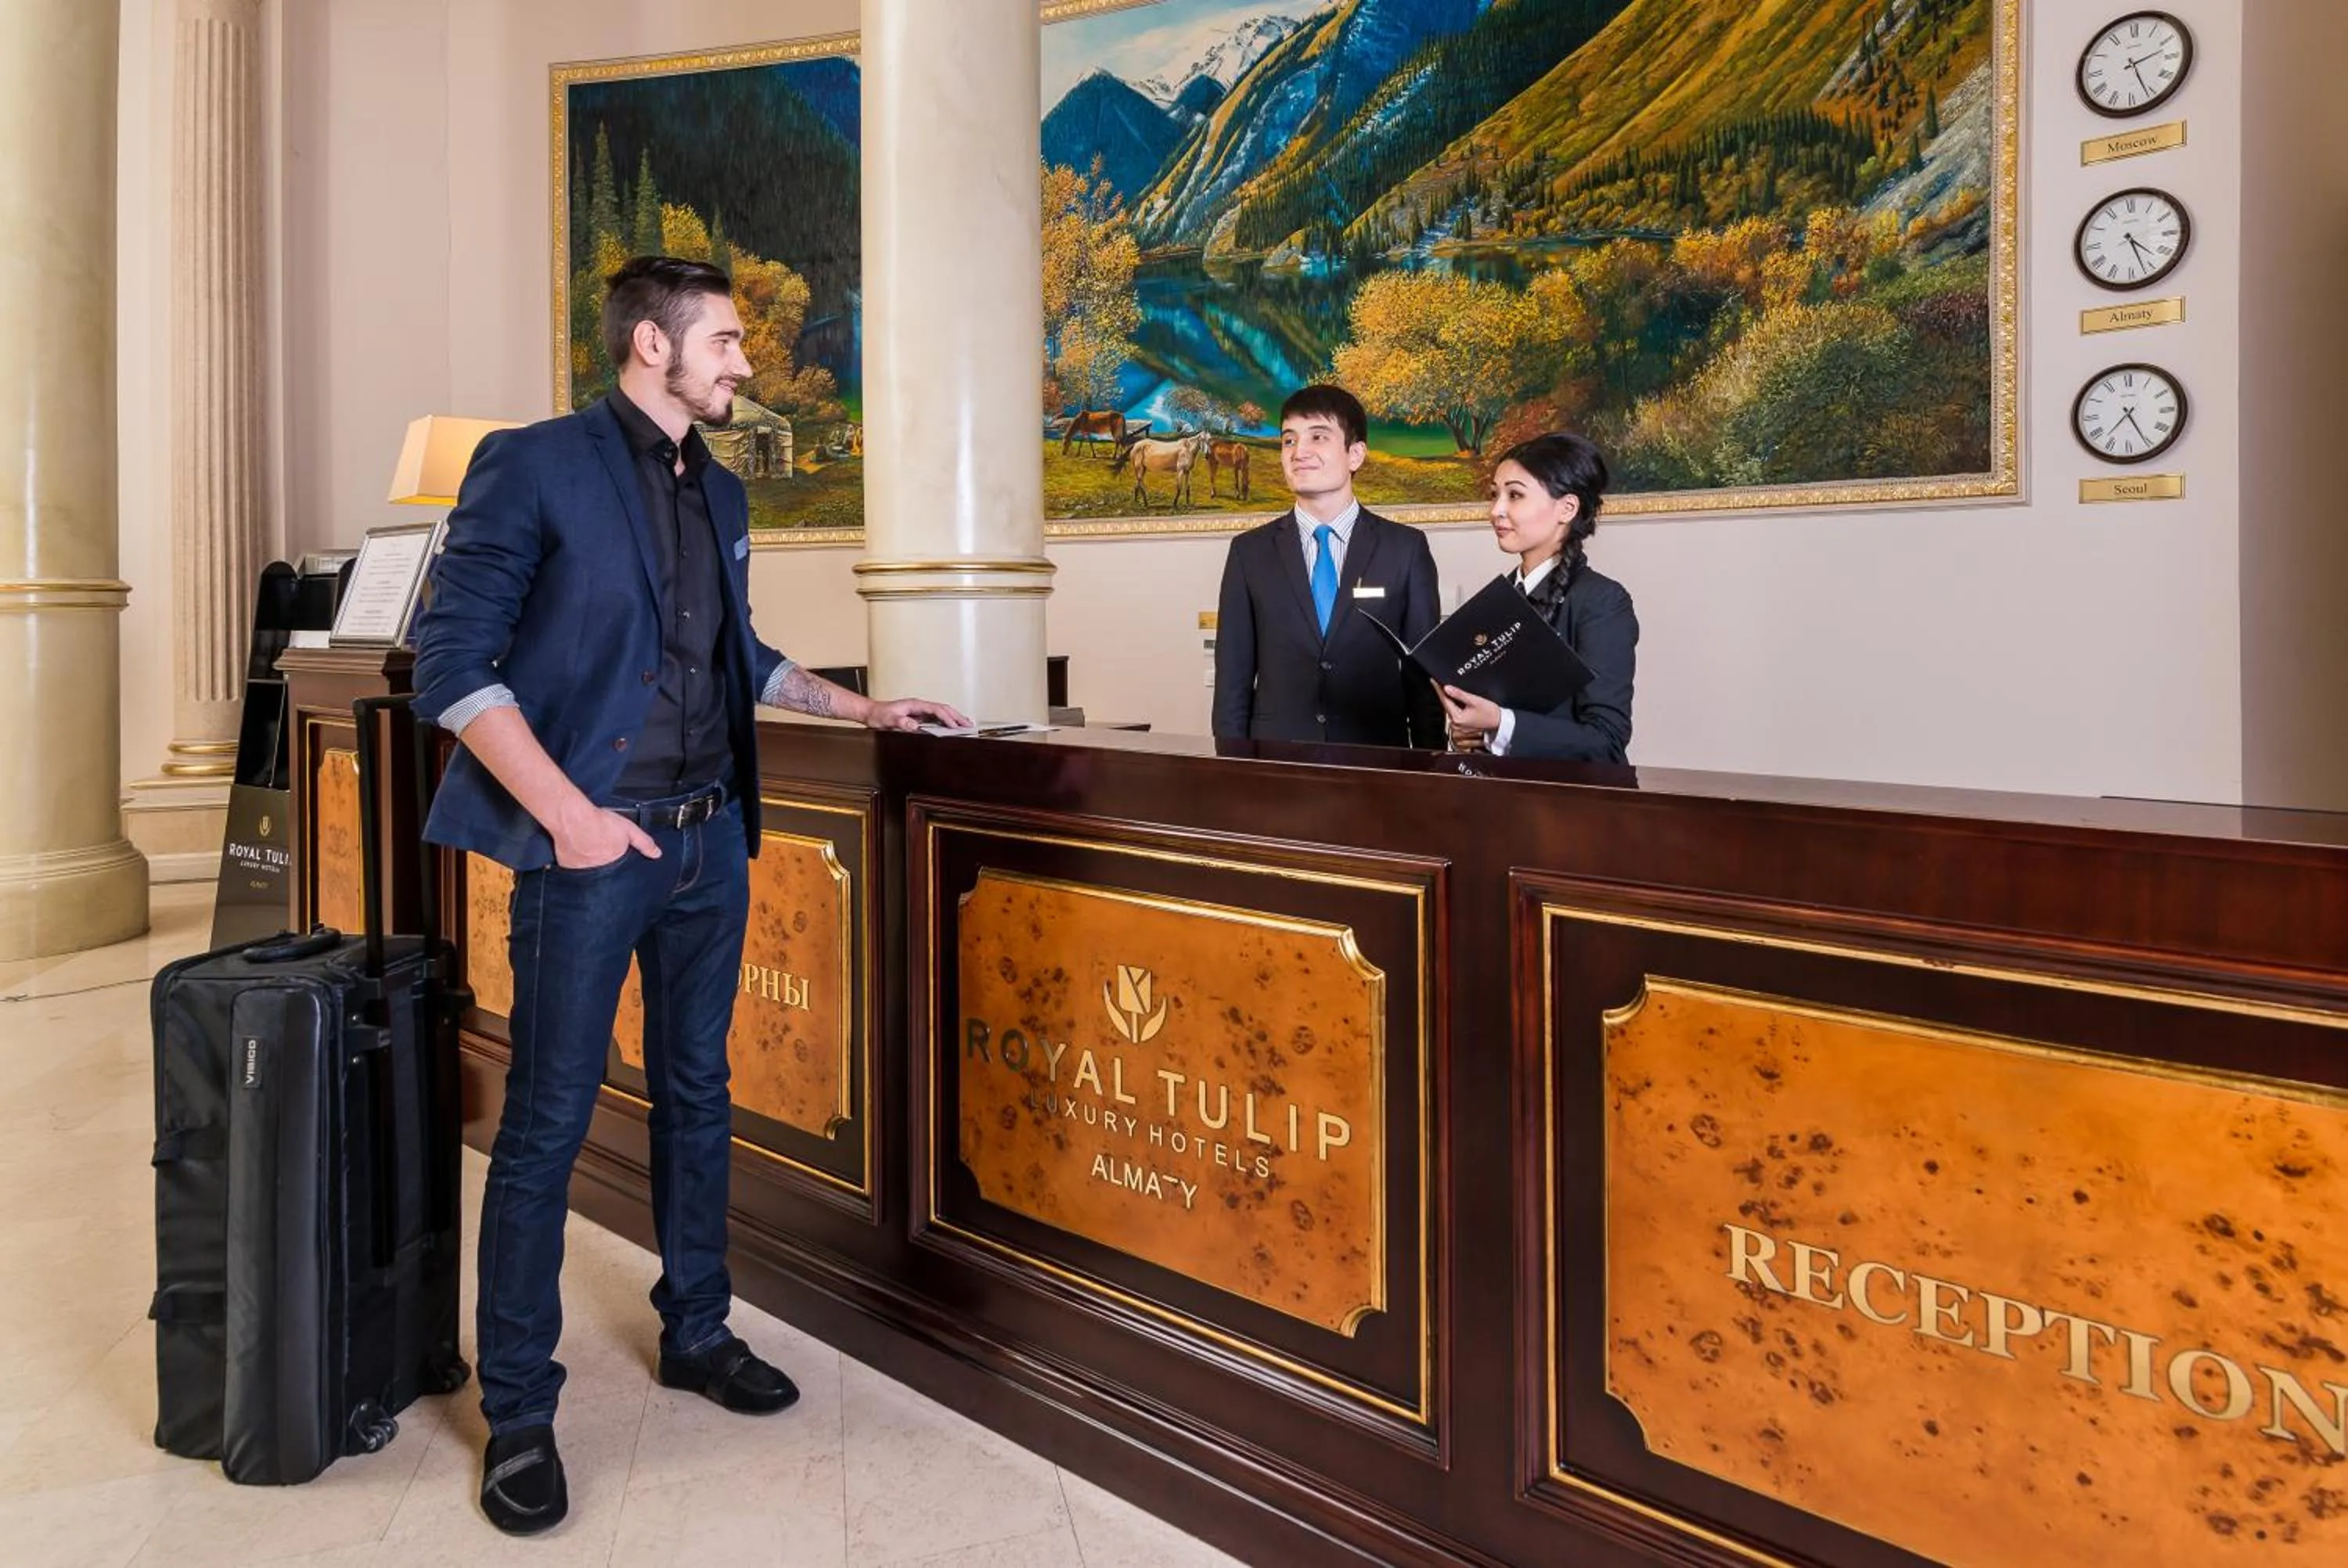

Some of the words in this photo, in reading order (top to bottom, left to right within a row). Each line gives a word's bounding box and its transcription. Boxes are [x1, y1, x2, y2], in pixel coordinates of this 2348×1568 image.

[2107, 135, 2159, 154] Moscow
[2109, 308, 2154, 323] Almaty
[2114, 483, 2148, 495] Seoul
[1457, 649, 1490, 675] ROYAL
[1491, 622, 1521, 647] TULIP
[229, 843, 261, 860] ROYAL
[266, 849, 290, 865] TULI
[739, 963, 809, 1011] РНЫ
[967, 1017, 1136, 1105] ROYAL
[1158, 1069, 1351, 1161] TULIP
[1031, 1088, 1137, 1138] LUXURY
[1149, 1123, 1269, 1178] HOTELS
[1723, 1224, 2348, 1455] RECEPTION
